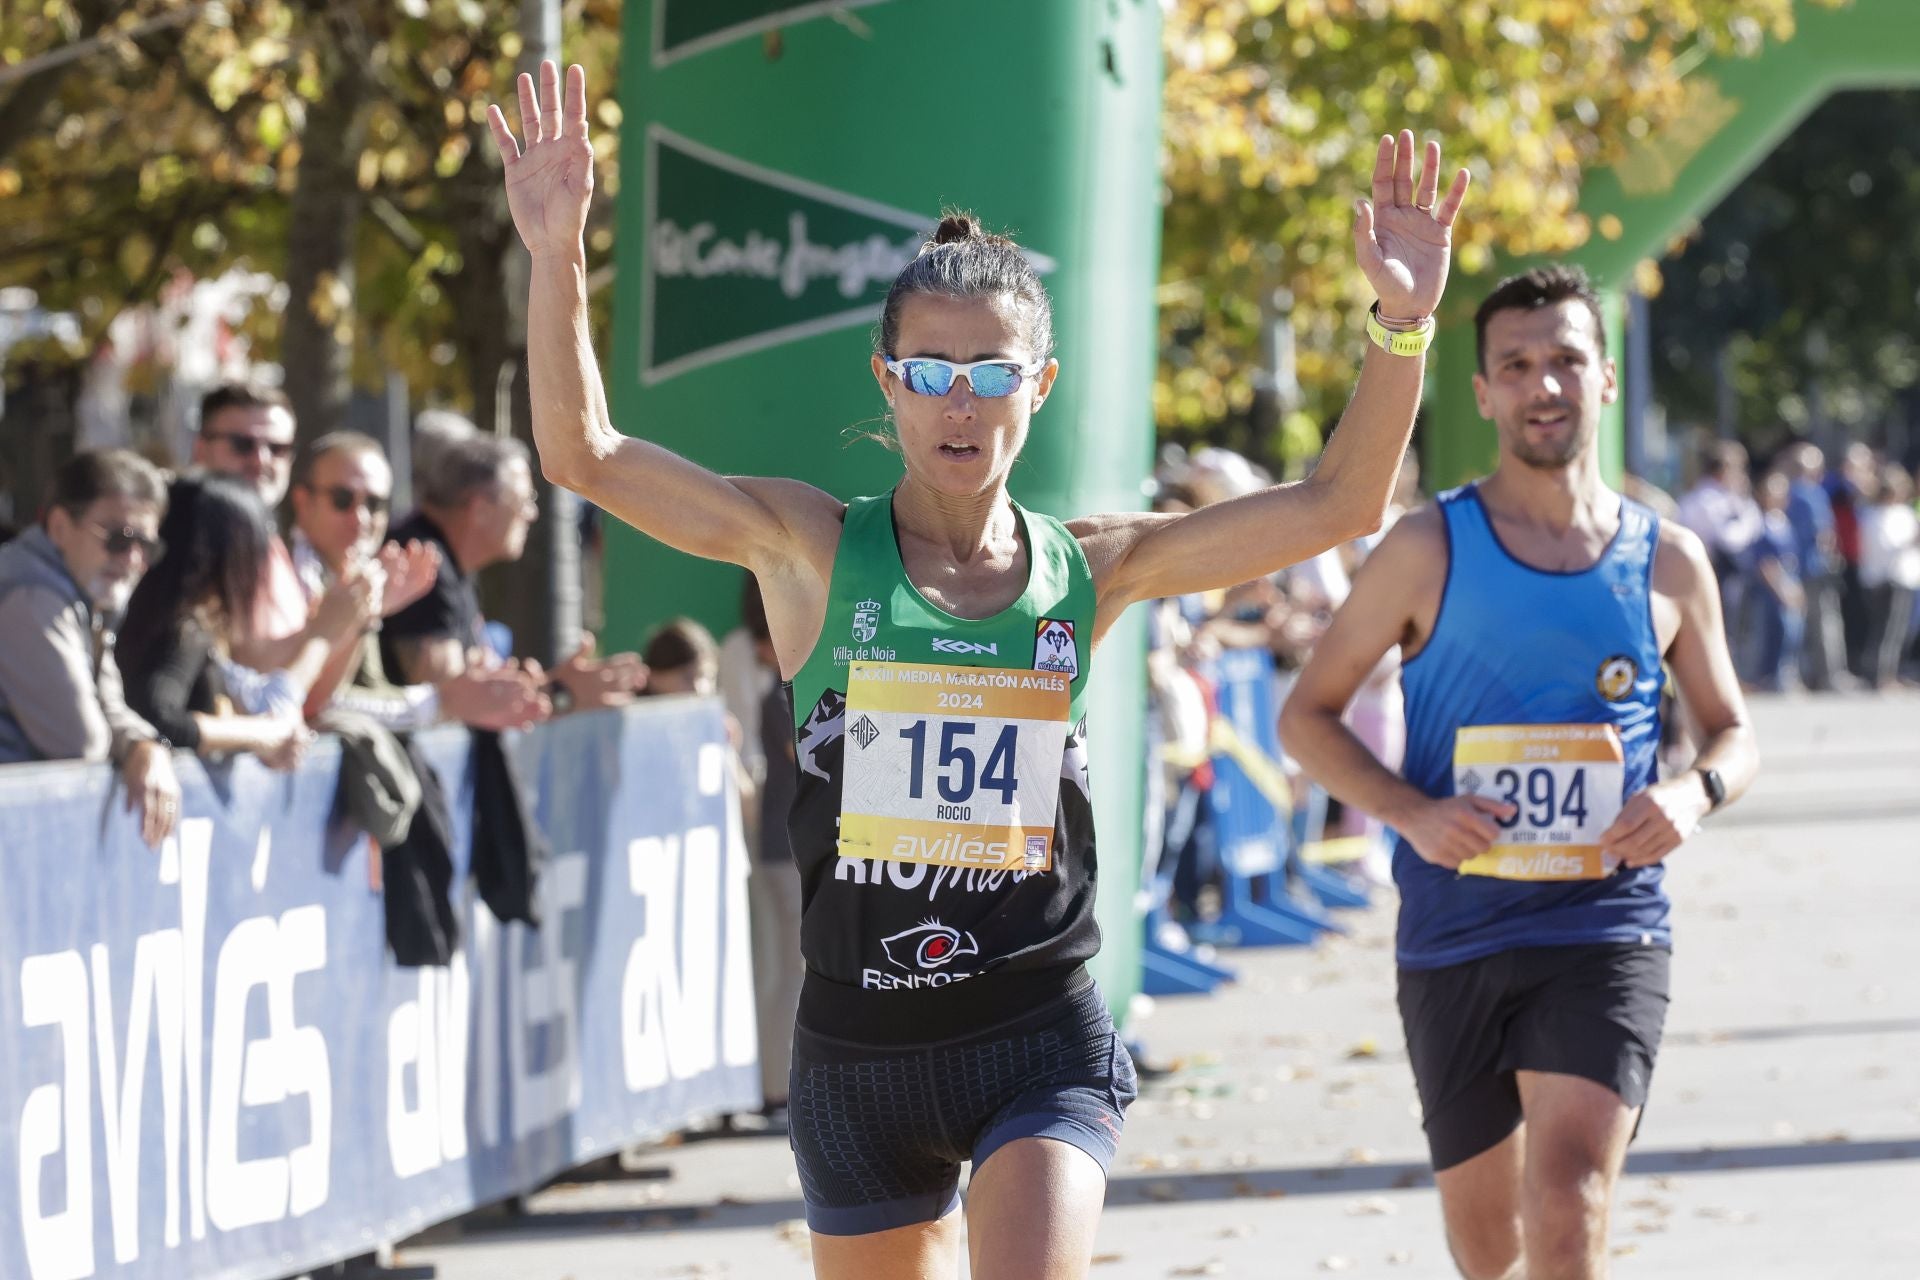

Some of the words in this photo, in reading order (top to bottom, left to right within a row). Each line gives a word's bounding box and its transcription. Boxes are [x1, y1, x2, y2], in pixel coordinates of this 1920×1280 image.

[833, 646, 853, 660] Villa
[855, 646, 869, 660] de
[871, 645, 896, 662] Noja
[897, 671, 942, 685] MEDIA
[945, 671, 1018, 689] MARATÓN
[1020, 676, 1065, 692] AVILÉS
[937, 692, 984, 709] 2024
[899, 720, 1018, 805] 154
[1494, 767, 1588, 829] 394
[936, 804, 971, 821] ROCIO
[892, 832, 1009, 865] avilés
